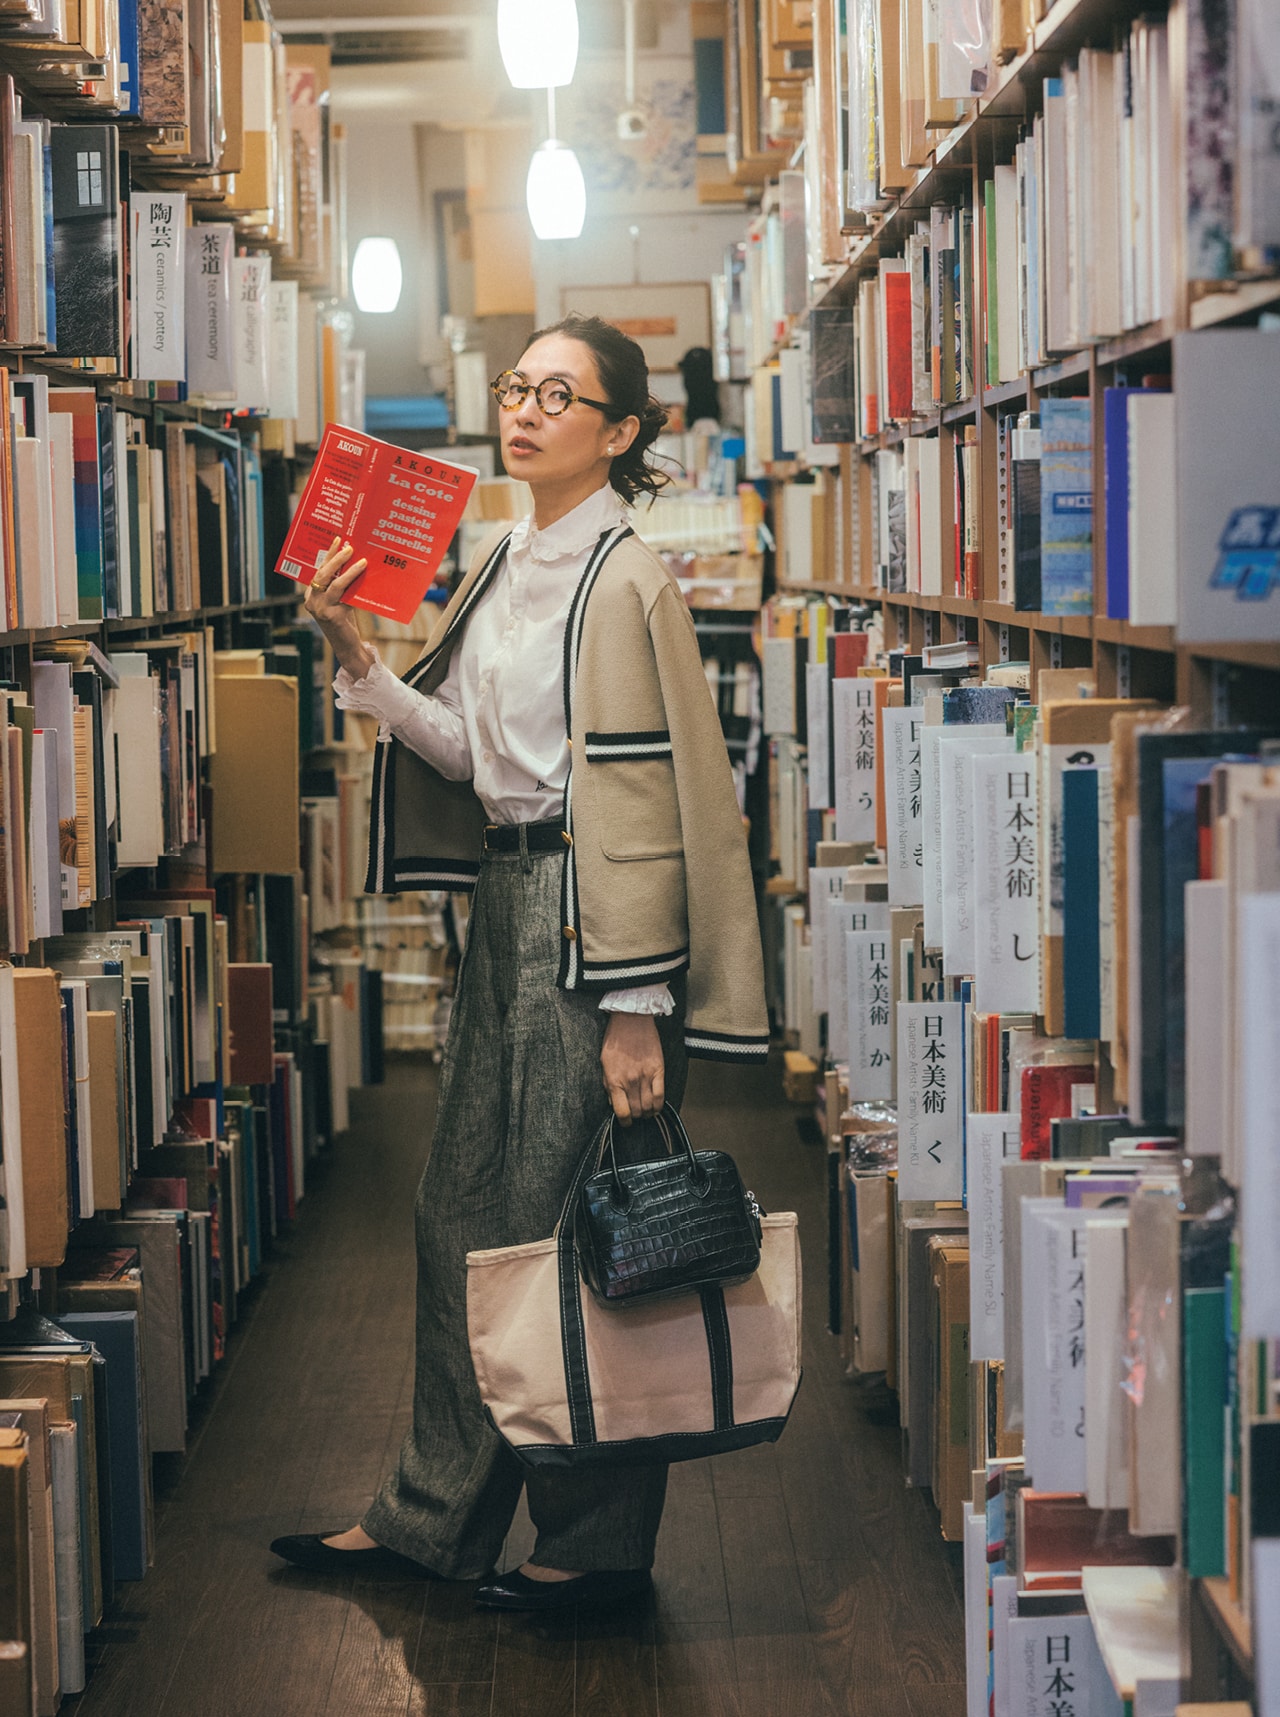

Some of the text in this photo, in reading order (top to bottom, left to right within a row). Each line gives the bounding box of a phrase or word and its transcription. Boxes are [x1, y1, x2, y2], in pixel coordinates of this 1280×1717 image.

[150, 203, 172, 248] 陶芸
[201, 234, 220, 275] 茶道
[156, 252, 167, 302] ceramics
[153, 311, 165, 352] pottery
[207, 279, 218, 361] tea ceremony
[337, 440, 363, 456] AKOUN
[388, 473, 454, 502] La Cote
[394, 456, 461, 485] AKOUN
[389, 510, 431, 530] pastels
[392, 498, 436, 519] dessins
[371, 528, 432, 554] aquarelles
[378, 518, 434, 543] gouaches
[383, 554, 407, 570] 1996
[856, 690, 874, 811] 日本美術 う
[893, 721, 904, 765] Japanese
[896, 766, 906, 795] Artists
[896, 797, 907, 828] Family
[899, 830, 907, 858] Name
[953, 755, 969, 932] Japanese Artists Family Name SA
[1004, 771, 1036, 962] 日本美術 し
[869, 942, 890, 1068] 日本美術 か
[907, 1016, 919, 1166] Japanese Artists Family Name KU
[921, 1015, 947, 1164] 日本美術 く
[980, 1132, 996, 1316] Japanese Artists Family Name SU
